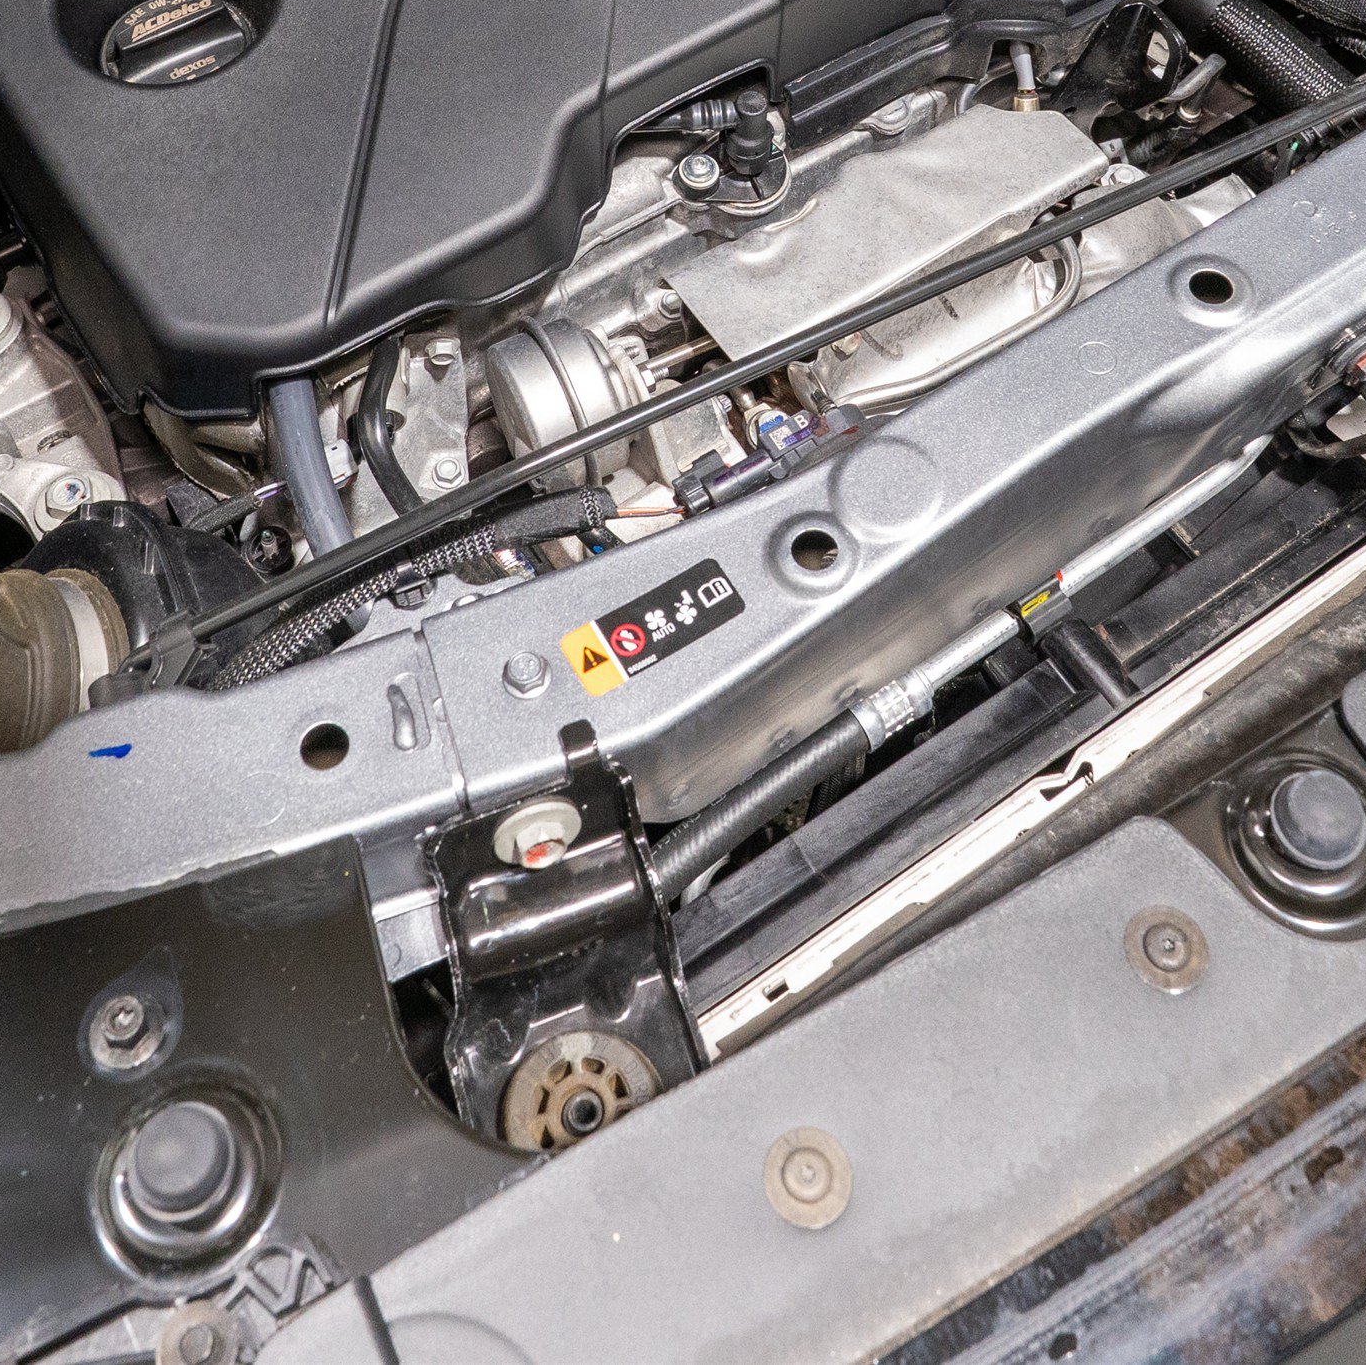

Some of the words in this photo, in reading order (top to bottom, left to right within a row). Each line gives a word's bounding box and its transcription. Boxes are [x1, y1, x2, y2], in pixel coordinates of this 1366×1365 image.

[124, 8, 146, 27] SAE
[169, 55, 216, 81] dexos
[651, 622, 677, 642] AUTO
